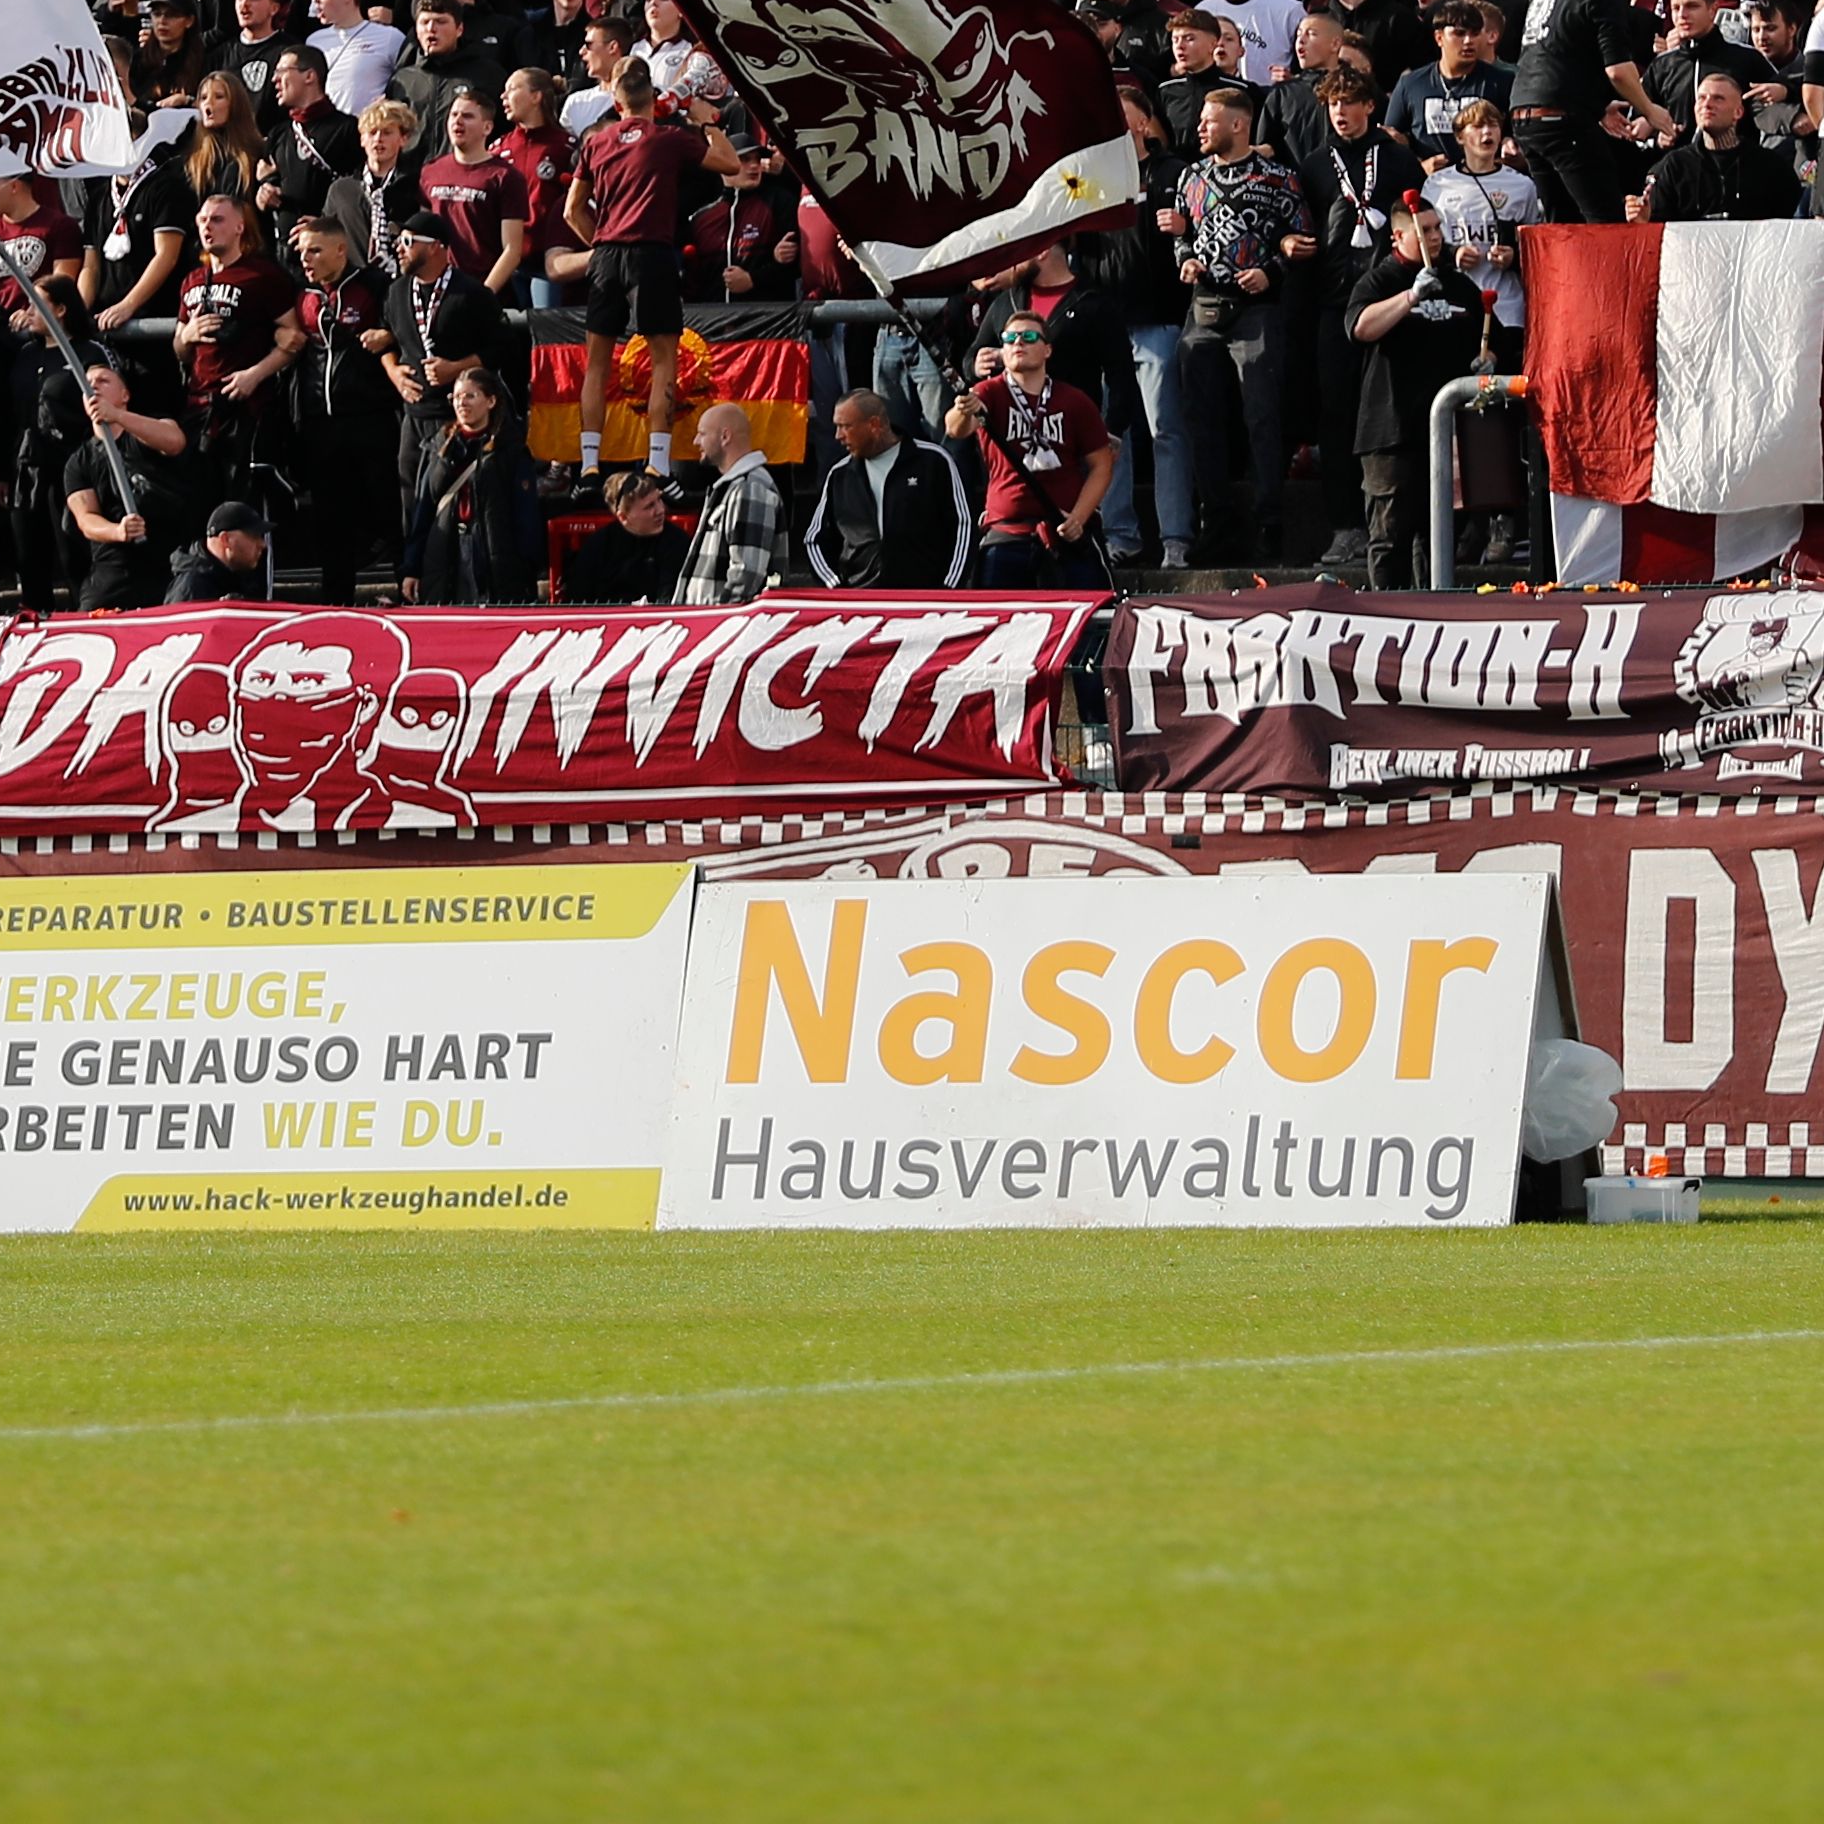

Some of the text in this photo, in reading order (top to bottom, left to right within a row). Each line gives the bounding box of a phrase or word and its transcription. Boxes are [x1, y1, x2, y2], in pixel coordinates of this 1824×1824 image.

[795, 69, 1049, 203] BANDA
[1007, 406, 1065, 444] EVAST
[455, 610, 1053, 778] INVICTA
[226, 894, 596, 928] BAUSTELLENSERVICE
[725, 898, 1500, 1087] Nascor
[60, 1033, 361, 1087] GENAUSO
[382, 1032, 553, 1082] HART
[261, 1099, 378, 1149] WIE
[400, 1098, 504, 1148] DU.
[709, 1114, 1476, 1220] Hausverwaltung
[122, 1183, 570, 1218] www.hack-werkzeughandel.de
